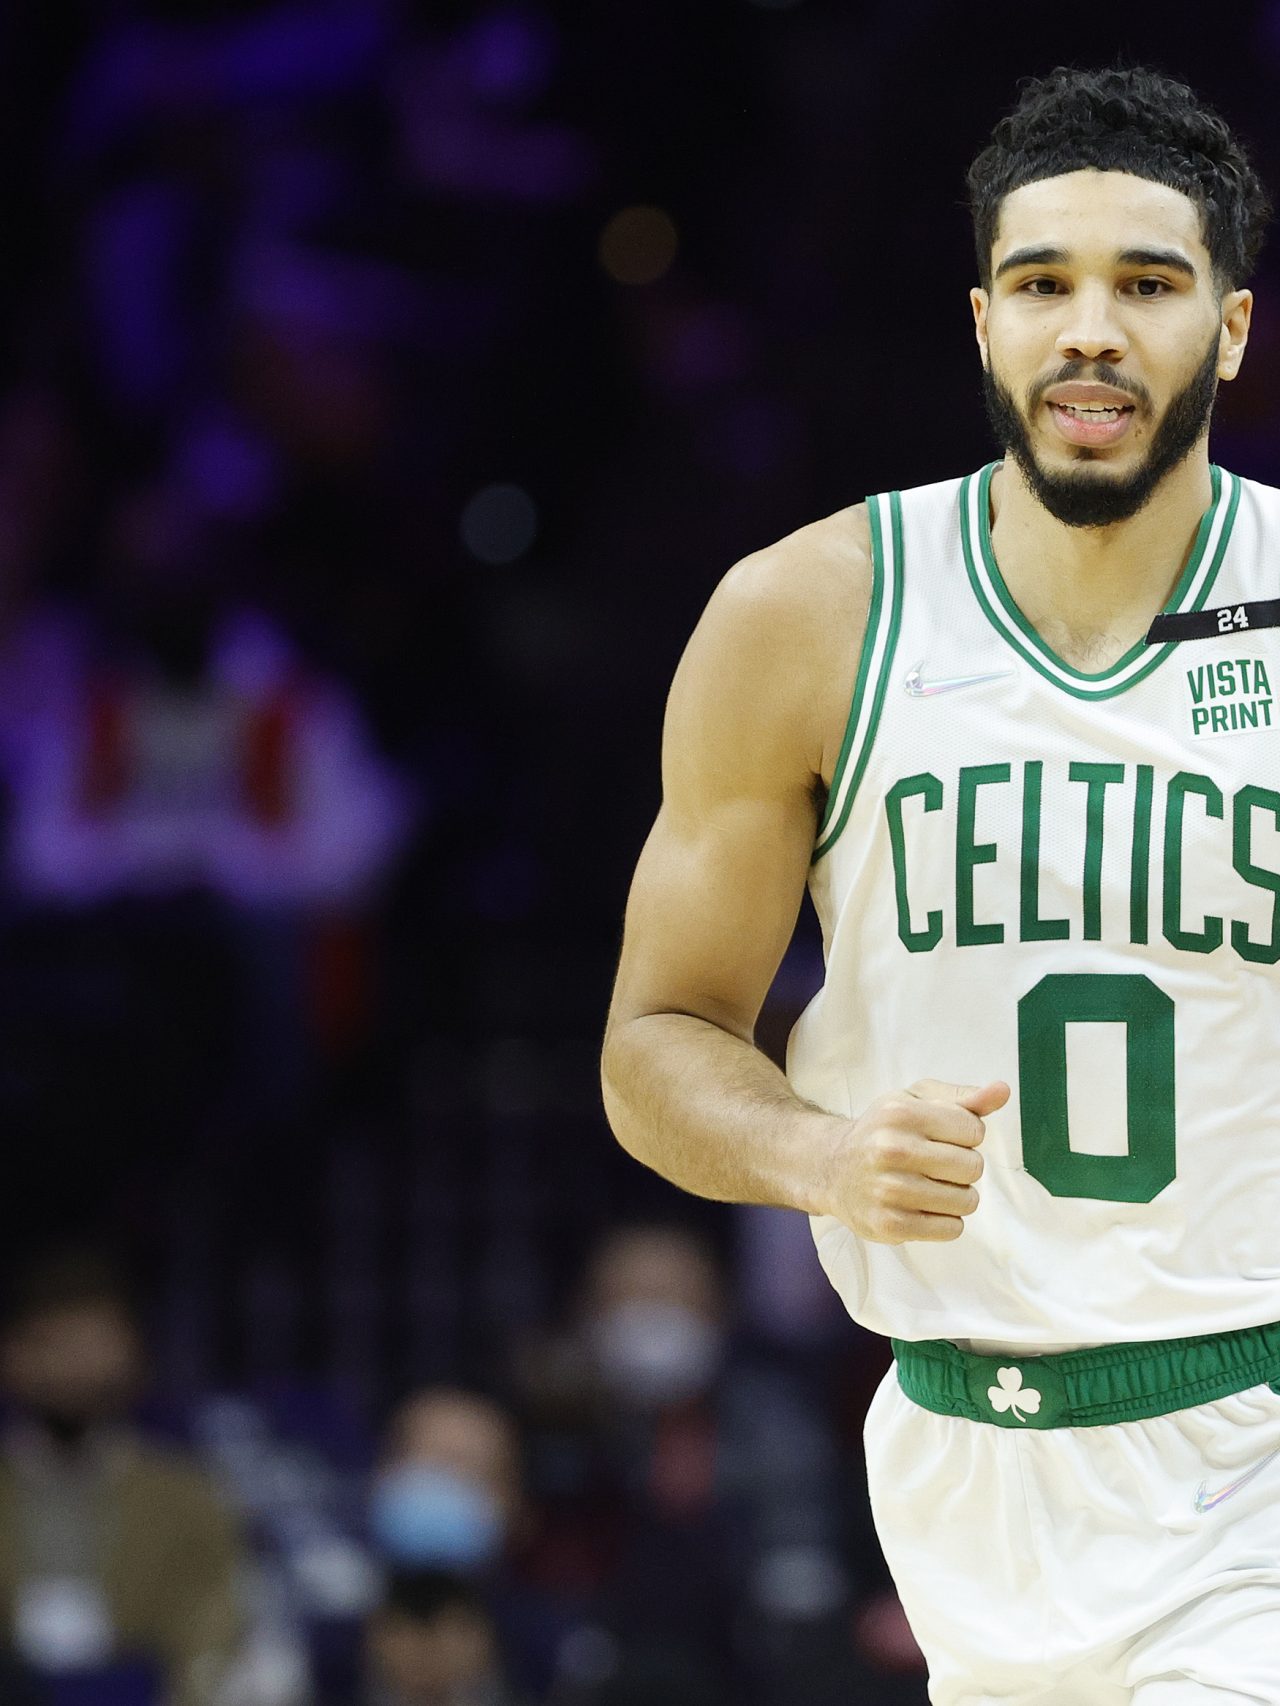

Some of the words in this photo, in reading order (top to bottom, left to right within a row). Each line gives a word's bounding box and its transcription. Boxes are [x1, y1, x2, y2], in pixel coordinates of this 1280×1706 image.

[1216, 605, 1249, 632] 24
[1187, 659, 1272, 704] VISTA
[1191, 699, 1273, 735] PRINT
[1018, 974, 1176, 1203] 0
